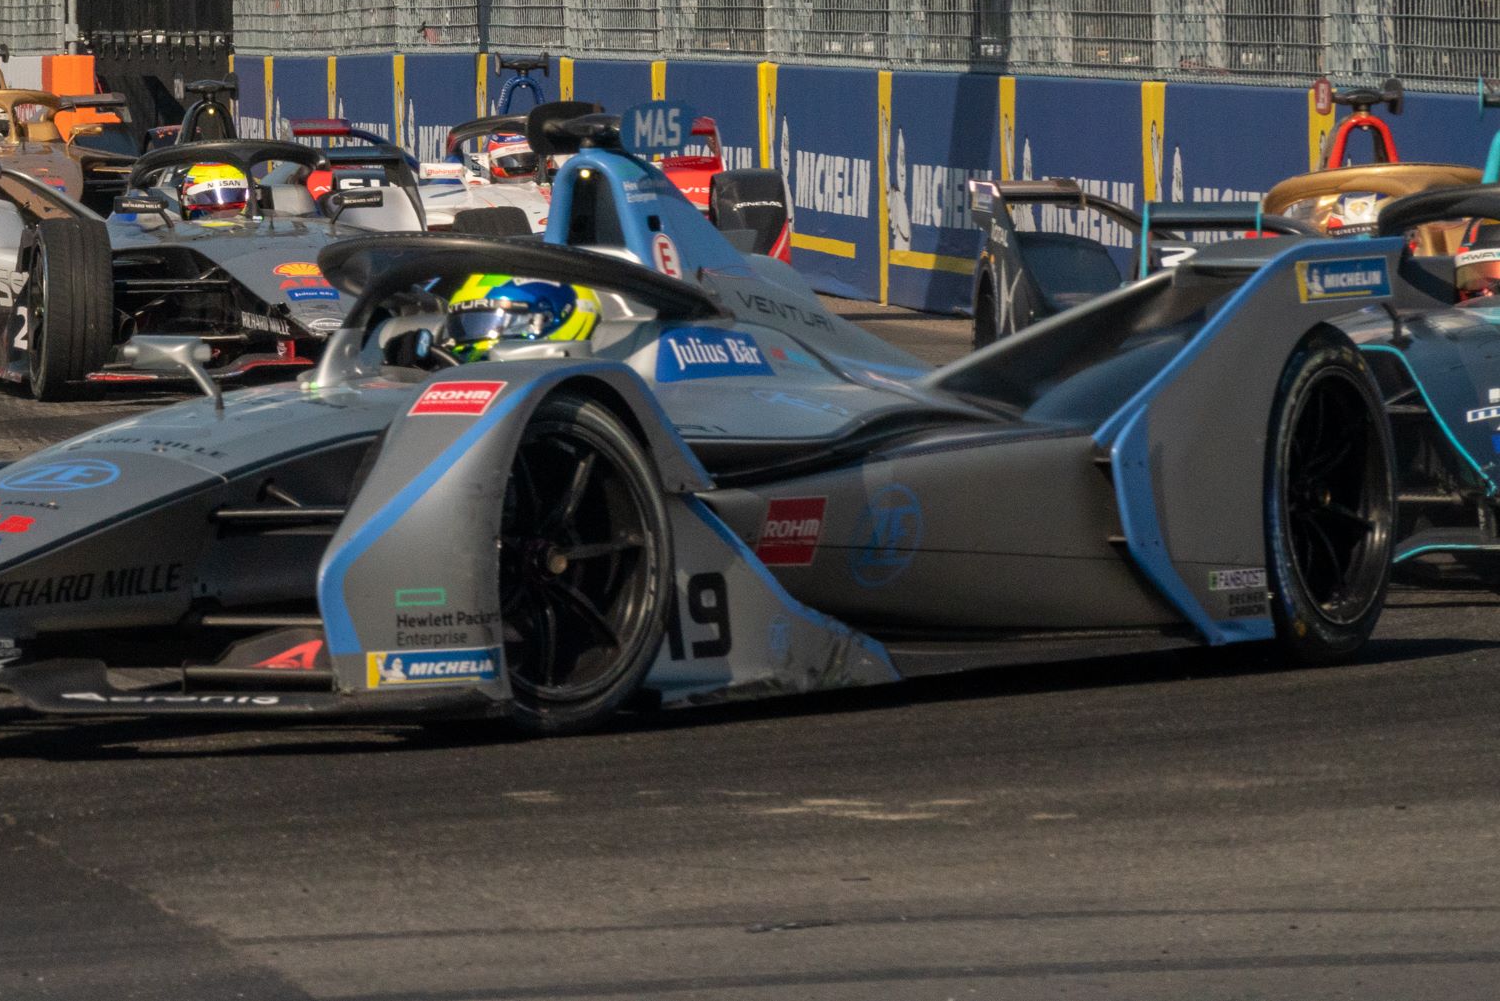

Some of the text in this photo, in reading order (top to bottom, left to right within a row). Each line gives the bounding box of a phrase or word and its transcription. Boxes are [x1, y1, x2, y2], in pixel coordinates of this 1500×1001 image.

[634, 108, 682, 148] MAS
[796, 149, 871, 219] MICHELIN
[657, 242, 677, 275] E
[1323, 269, 1383, 289] MICHELIN
[736, 290, 836, 333] VENTURI
[667, 336, 762, 370] Julius Bär
[424, 389, 493, 401] ROHM
[764, 519, 821, 538] ROHM
[101, 562, 185, 597] MILLE
[396, 613, 454, 628] Hewlett
[668, 571, 732, 660] 19
[396, 631, 469, 647] Enterprise
[409, 659, 495, 676] MICHELIN
